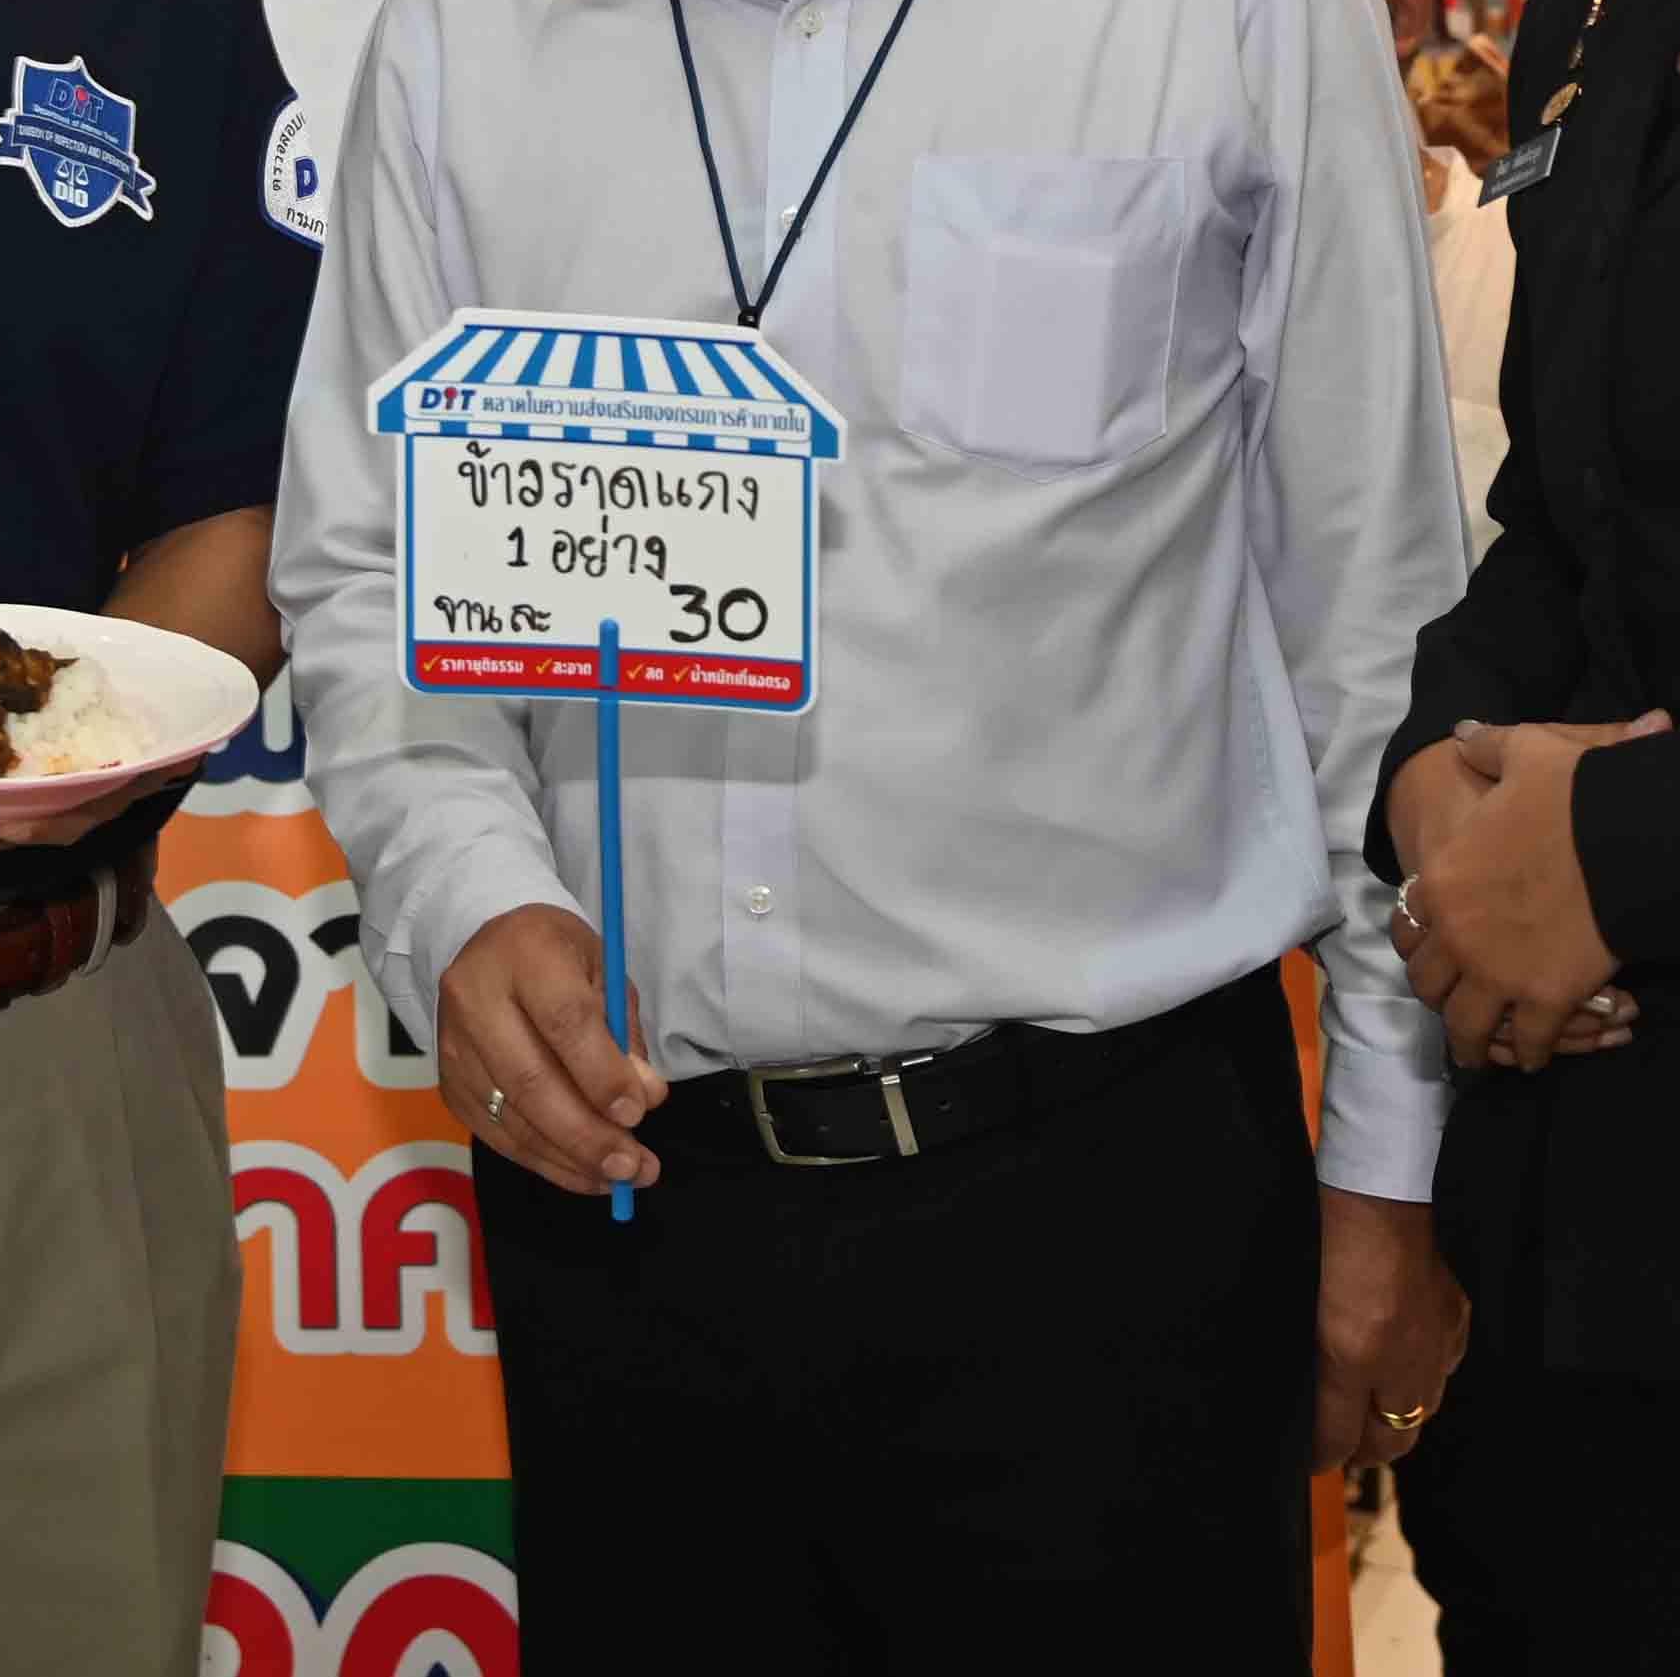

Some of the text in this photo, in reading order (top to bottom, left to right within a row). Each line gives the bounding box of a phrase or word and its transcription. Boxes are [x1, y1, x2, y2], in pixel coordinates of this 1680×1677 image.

[286, 207, 326, 236] กรมก
[420, 387, 476, 411] DIT
[457, 440, 760, 521] ข้าวราดแกง
[506, 514, 668, 581] 1 อย่าง
[669, 584, 769, 644] 30
